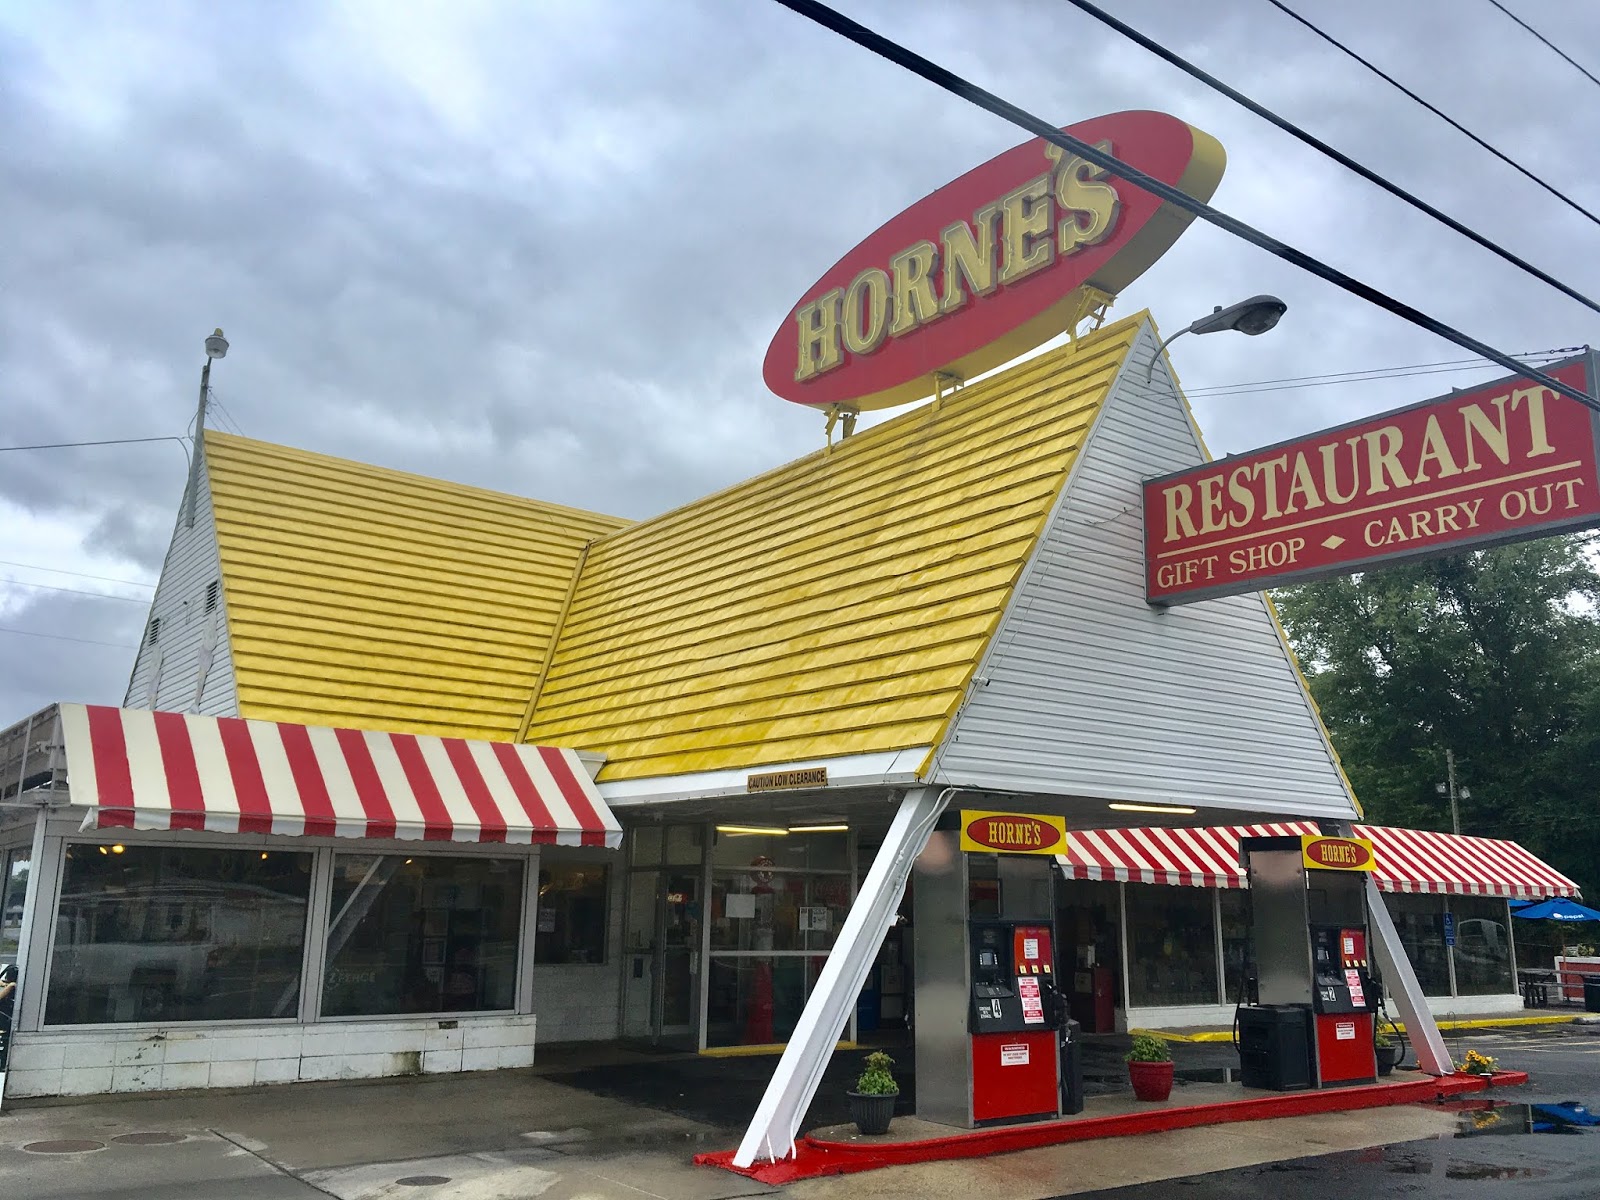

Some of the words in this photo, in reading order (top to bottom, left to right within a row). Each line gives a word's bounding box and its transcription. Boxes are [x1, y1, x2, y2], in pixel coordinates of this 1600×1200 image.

[794, 138, 1120, 382] HORNE'S
[1162, 376, 1561, 543] RESTAURANT
[1364, 498, 1484, 547] CARRY
[1500, 477, 1585, 520] OUT
[1157, 555, 1219, 588] GIFT
[1229, 537, 1305, 574] SHOP
[748, 775, 773, 790] CAUTION
[774, 773, 788, 787] LOW
[789, 770, 825, 785] CLEARANCE
[988, 820, 1042, 846] HORNE'S
[1320, 843, 1357, 864] HORNE'S
